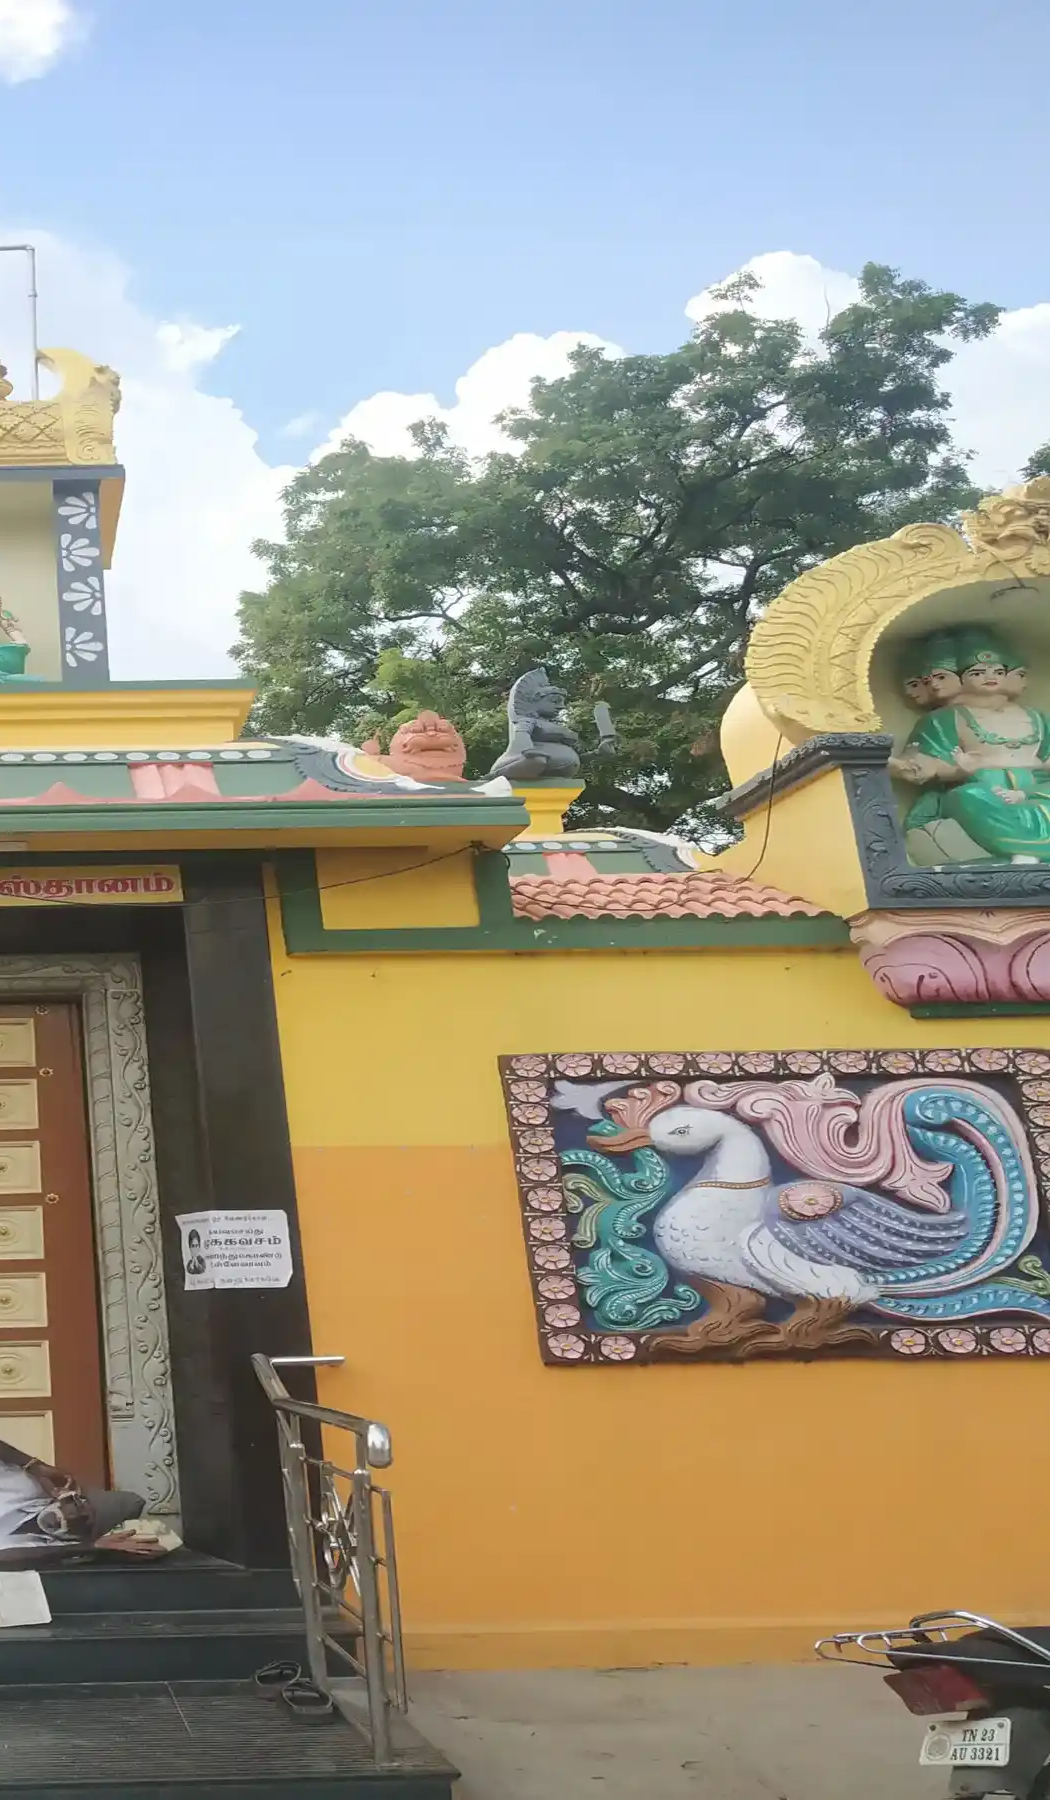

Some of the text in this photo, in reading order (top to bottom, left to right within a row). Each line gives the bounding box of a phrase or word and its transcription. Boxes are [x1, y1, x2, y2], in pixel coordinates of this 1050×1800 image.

[962, 1728, 996, 1742] TN 23
[950, 1747, 1000, 1761] AU 3321
